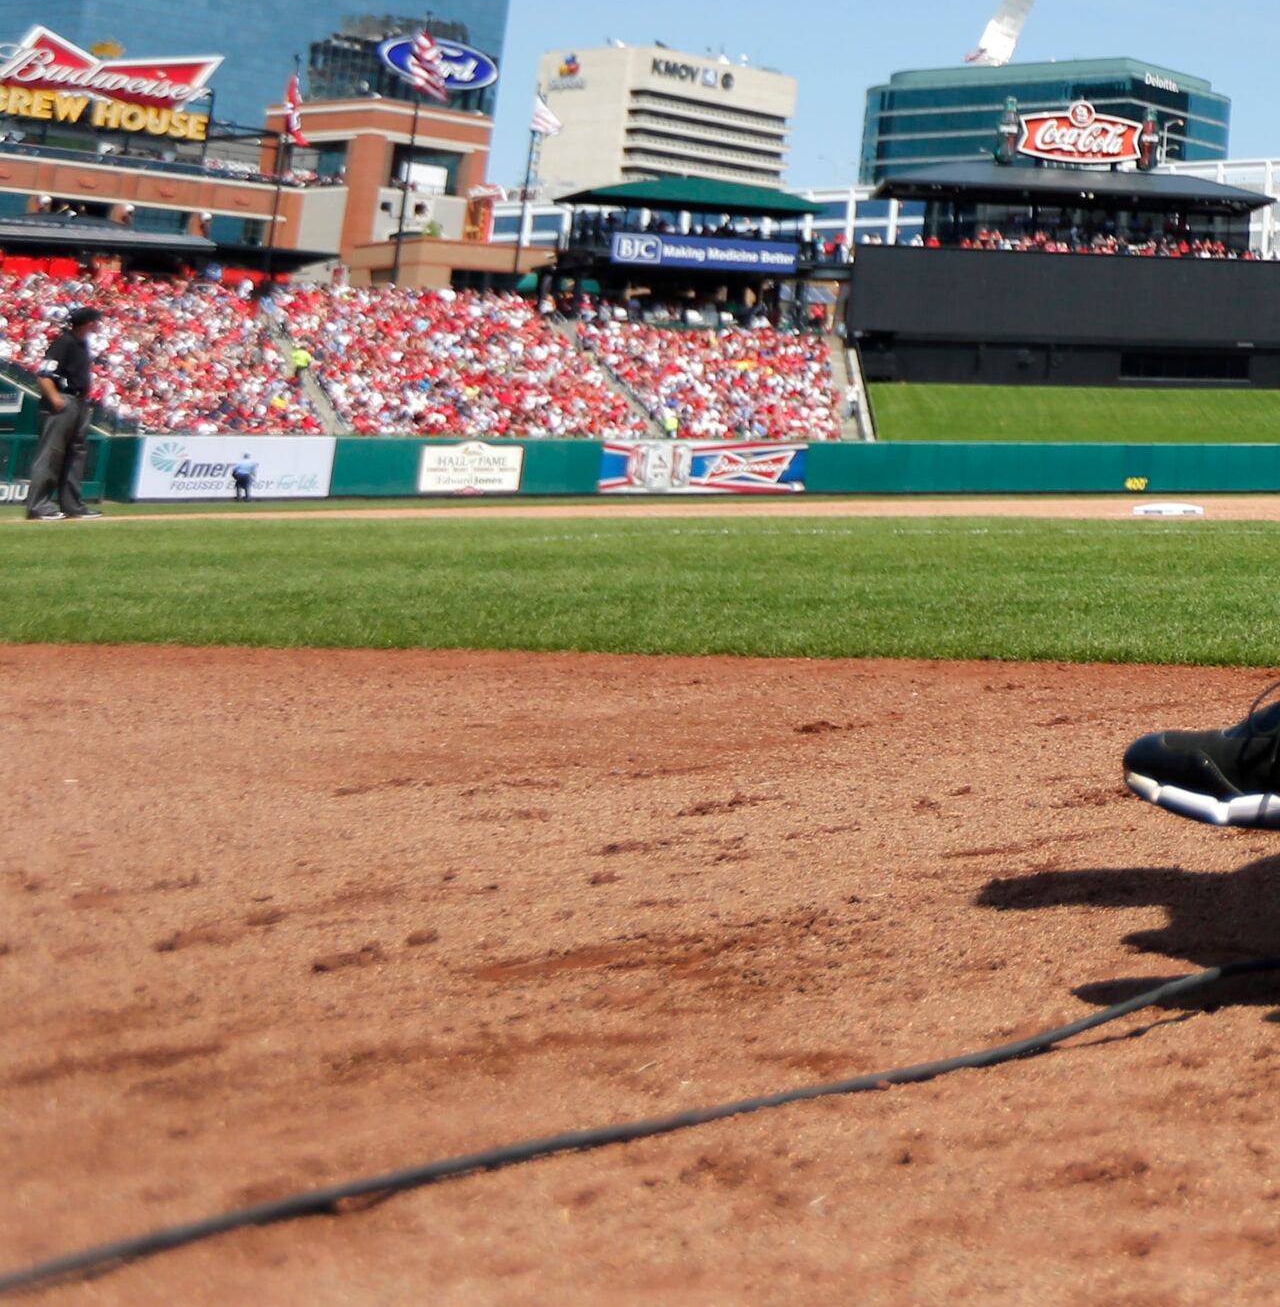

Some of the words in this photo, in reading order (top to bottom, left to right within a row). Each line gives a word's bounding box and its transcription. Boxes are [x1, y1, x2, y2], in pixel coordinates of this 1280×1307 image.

[0, 43, 212, 102] Budweiser
[92, 99, 210, 141] HOUSE
[620, 238, 657, 261] BJC
[663, 245, 705, 262] Making
[707, 246, 759, 263] Medicine
[761, 250, 796, 265] Better
[174, 459, 236, 478] Amer
